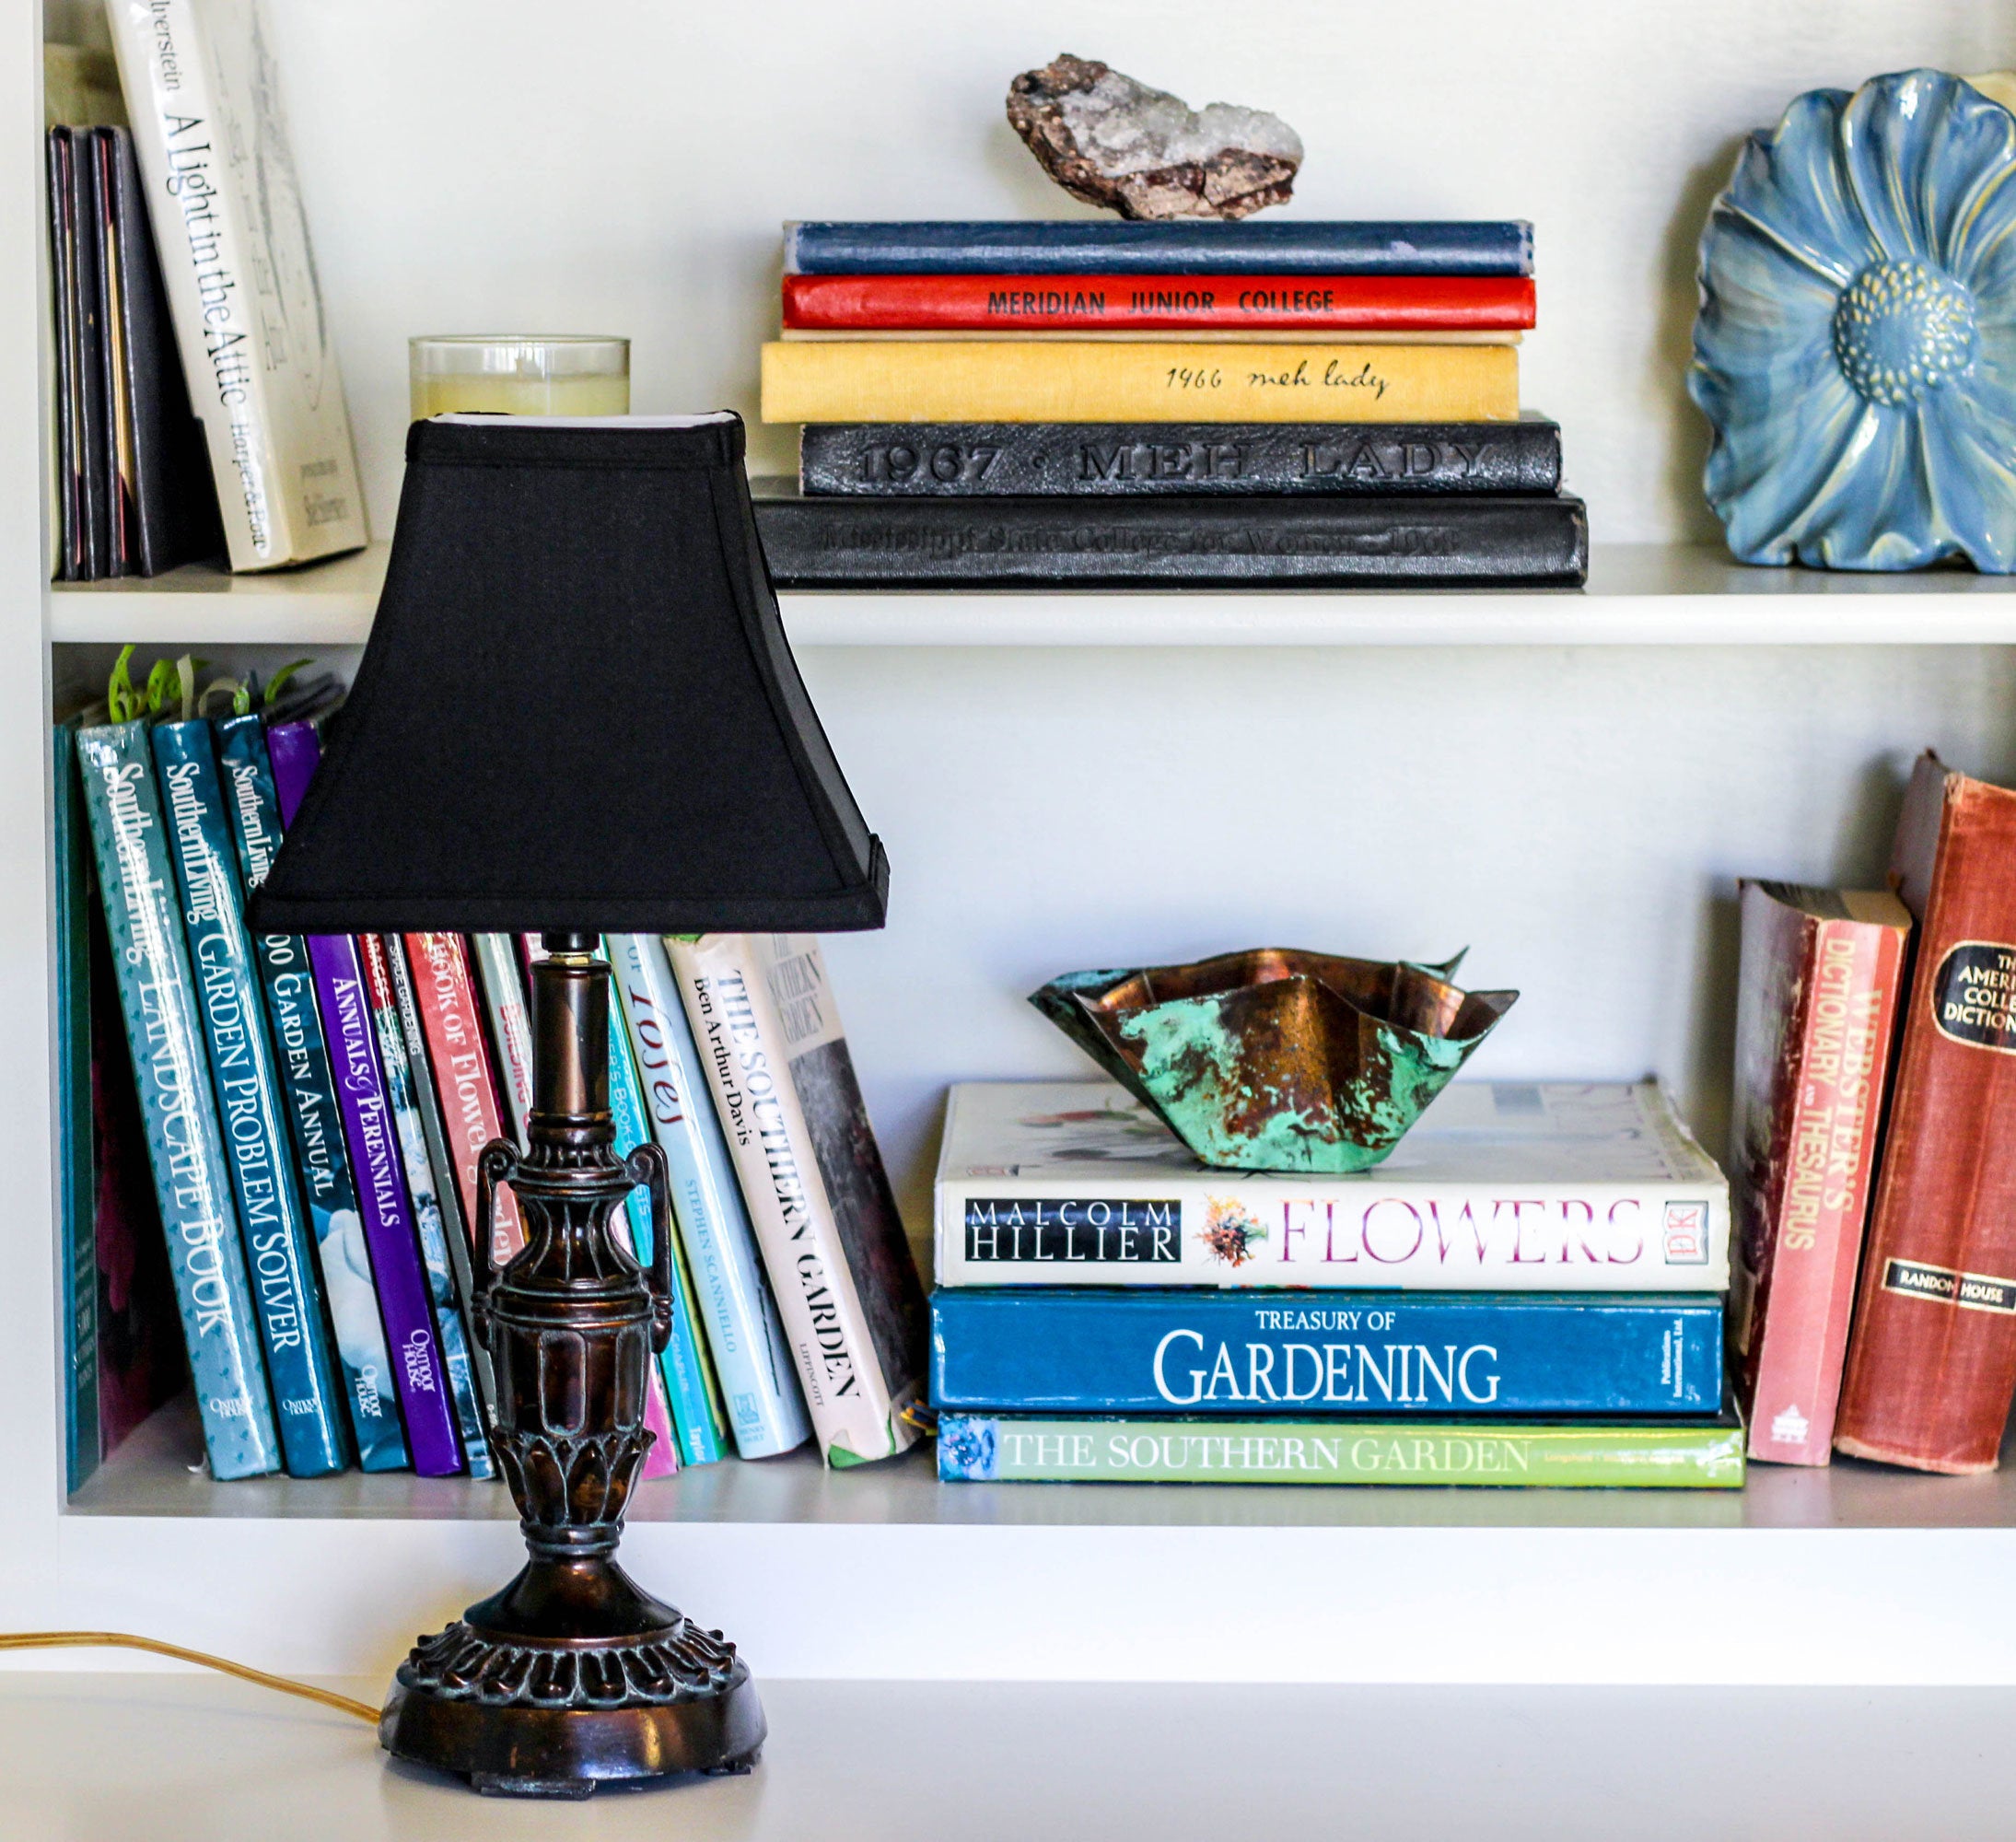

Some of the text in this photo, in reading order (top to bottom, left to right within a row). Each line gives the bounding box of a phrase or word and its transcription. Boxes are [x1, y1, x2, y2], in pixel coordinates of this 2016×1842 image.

[164, 112, 205, 137] A
[167, 142, 220, 228] Light
[188, 232, 224, 267] in
[197, 270, 236, 324] the
[987, 290, 1334, 314] MERIDIAN JUNIOR COLLEGE
[204, 329, 251, 406] Attic
[1248, 360, 1311, 386] meh
[1322, 359, 1390, 400] lady
[859, 443, 1493, 482] 1967 MEH LADY
[198, 933, 250, 1068] GARDEN
[429, 943, 459, 1011] BOOK
[397, 986, 422, 1055] GARDENING
[442, 1014, 467, 1046] OF
[1811, 938, 1857, 1087] DICTIONARY
[274, 973, 312, 1080] GARDEN
[296, 1089, 333, 1196] ANNUAL
[693, 976, 752, 1146] Ben Arthur Davis
[332, 977, 370, 1077] ANNUALS
[356, 1094, 401, 1228] PERENNIALS
[614, 1087, 635, 1136] BOOK
[1824, 988, 1882, 1213] WEBSTER'S
[223, 1074, 279, 1228] PROBLEM
[717, 969, 861, 1398] THE SOUTHERN GARDEN
[1784, 1107, 1834, 1252] THESAURUS
[971, 1201, 1172, 1226] MALCOLM
[972, 1226, 1176, 1260] HILLIER
[1277, 1197, 1644, 1265] FLOWERS
[181, 1213, 230, 1338] BOOK
[252, 1231, 301, 1354] SOLVER
[685, 1178, 736, 1354] STEPHEN SCANNIELLO
[1961, 1282, 2004, 1304] HOUSE
[1255, 1310, 1396, 1331] TREASURY OF
[799, 1342, 824, 1408] LIPPINCOTT
[1153, 1329, 1500, 1405] GARDENING
[1661, 1330, 1672, 1384] Publications
[690, 1427, 705, 1462] Taylor
[1004, 1434, 1097, 1467] THE
[1108, 1435, 1342, 1471] SOUTHERN
[1351, 1437, 1532, 1472] GARDEN
